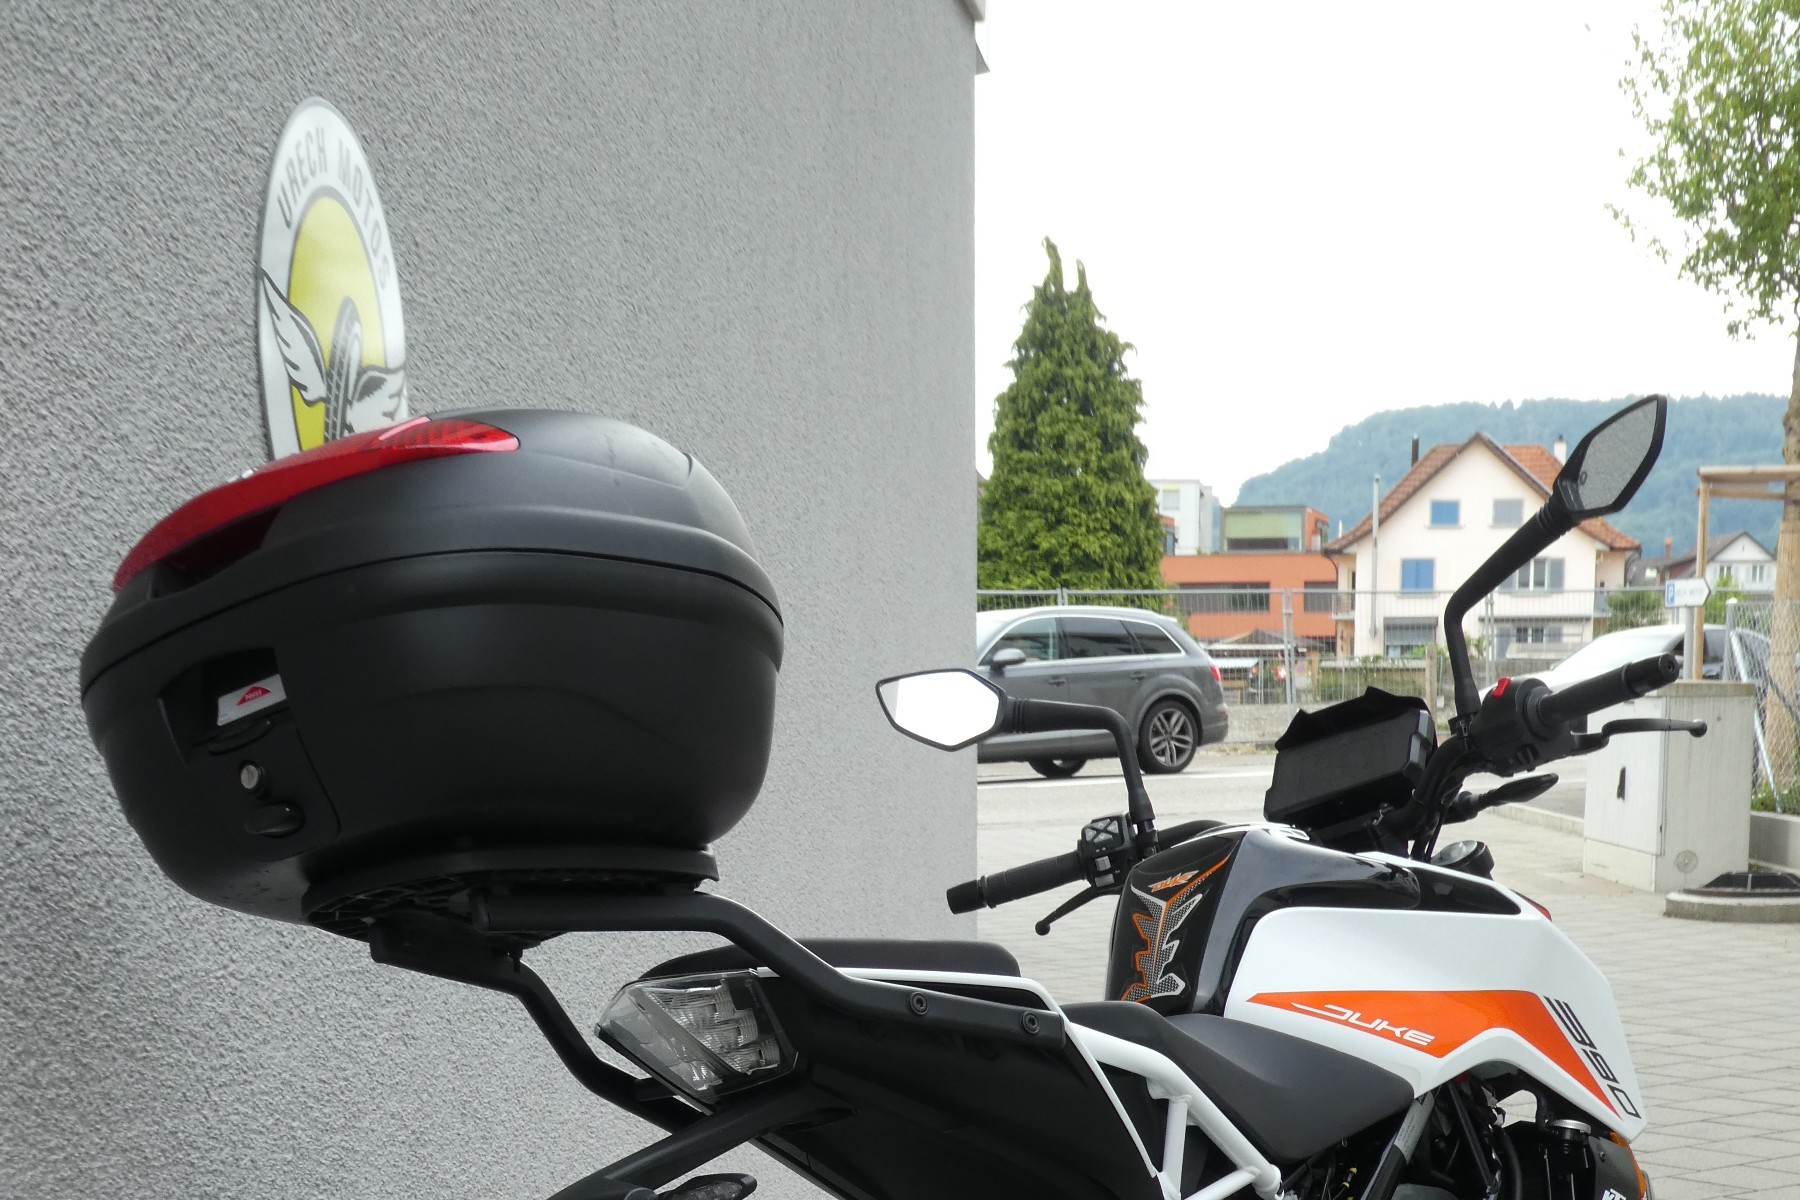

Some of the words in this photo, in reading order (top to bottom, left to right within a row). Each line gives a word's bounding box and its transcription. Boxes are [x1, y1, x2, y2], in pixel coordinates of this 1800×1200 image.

[276, 126, 328, 230] URECH
[337, 138, 391, 291] MOTOS
[1291, 1002, 1435, 1046] DUKE
[1543, 995, 1641, 1119] 390
